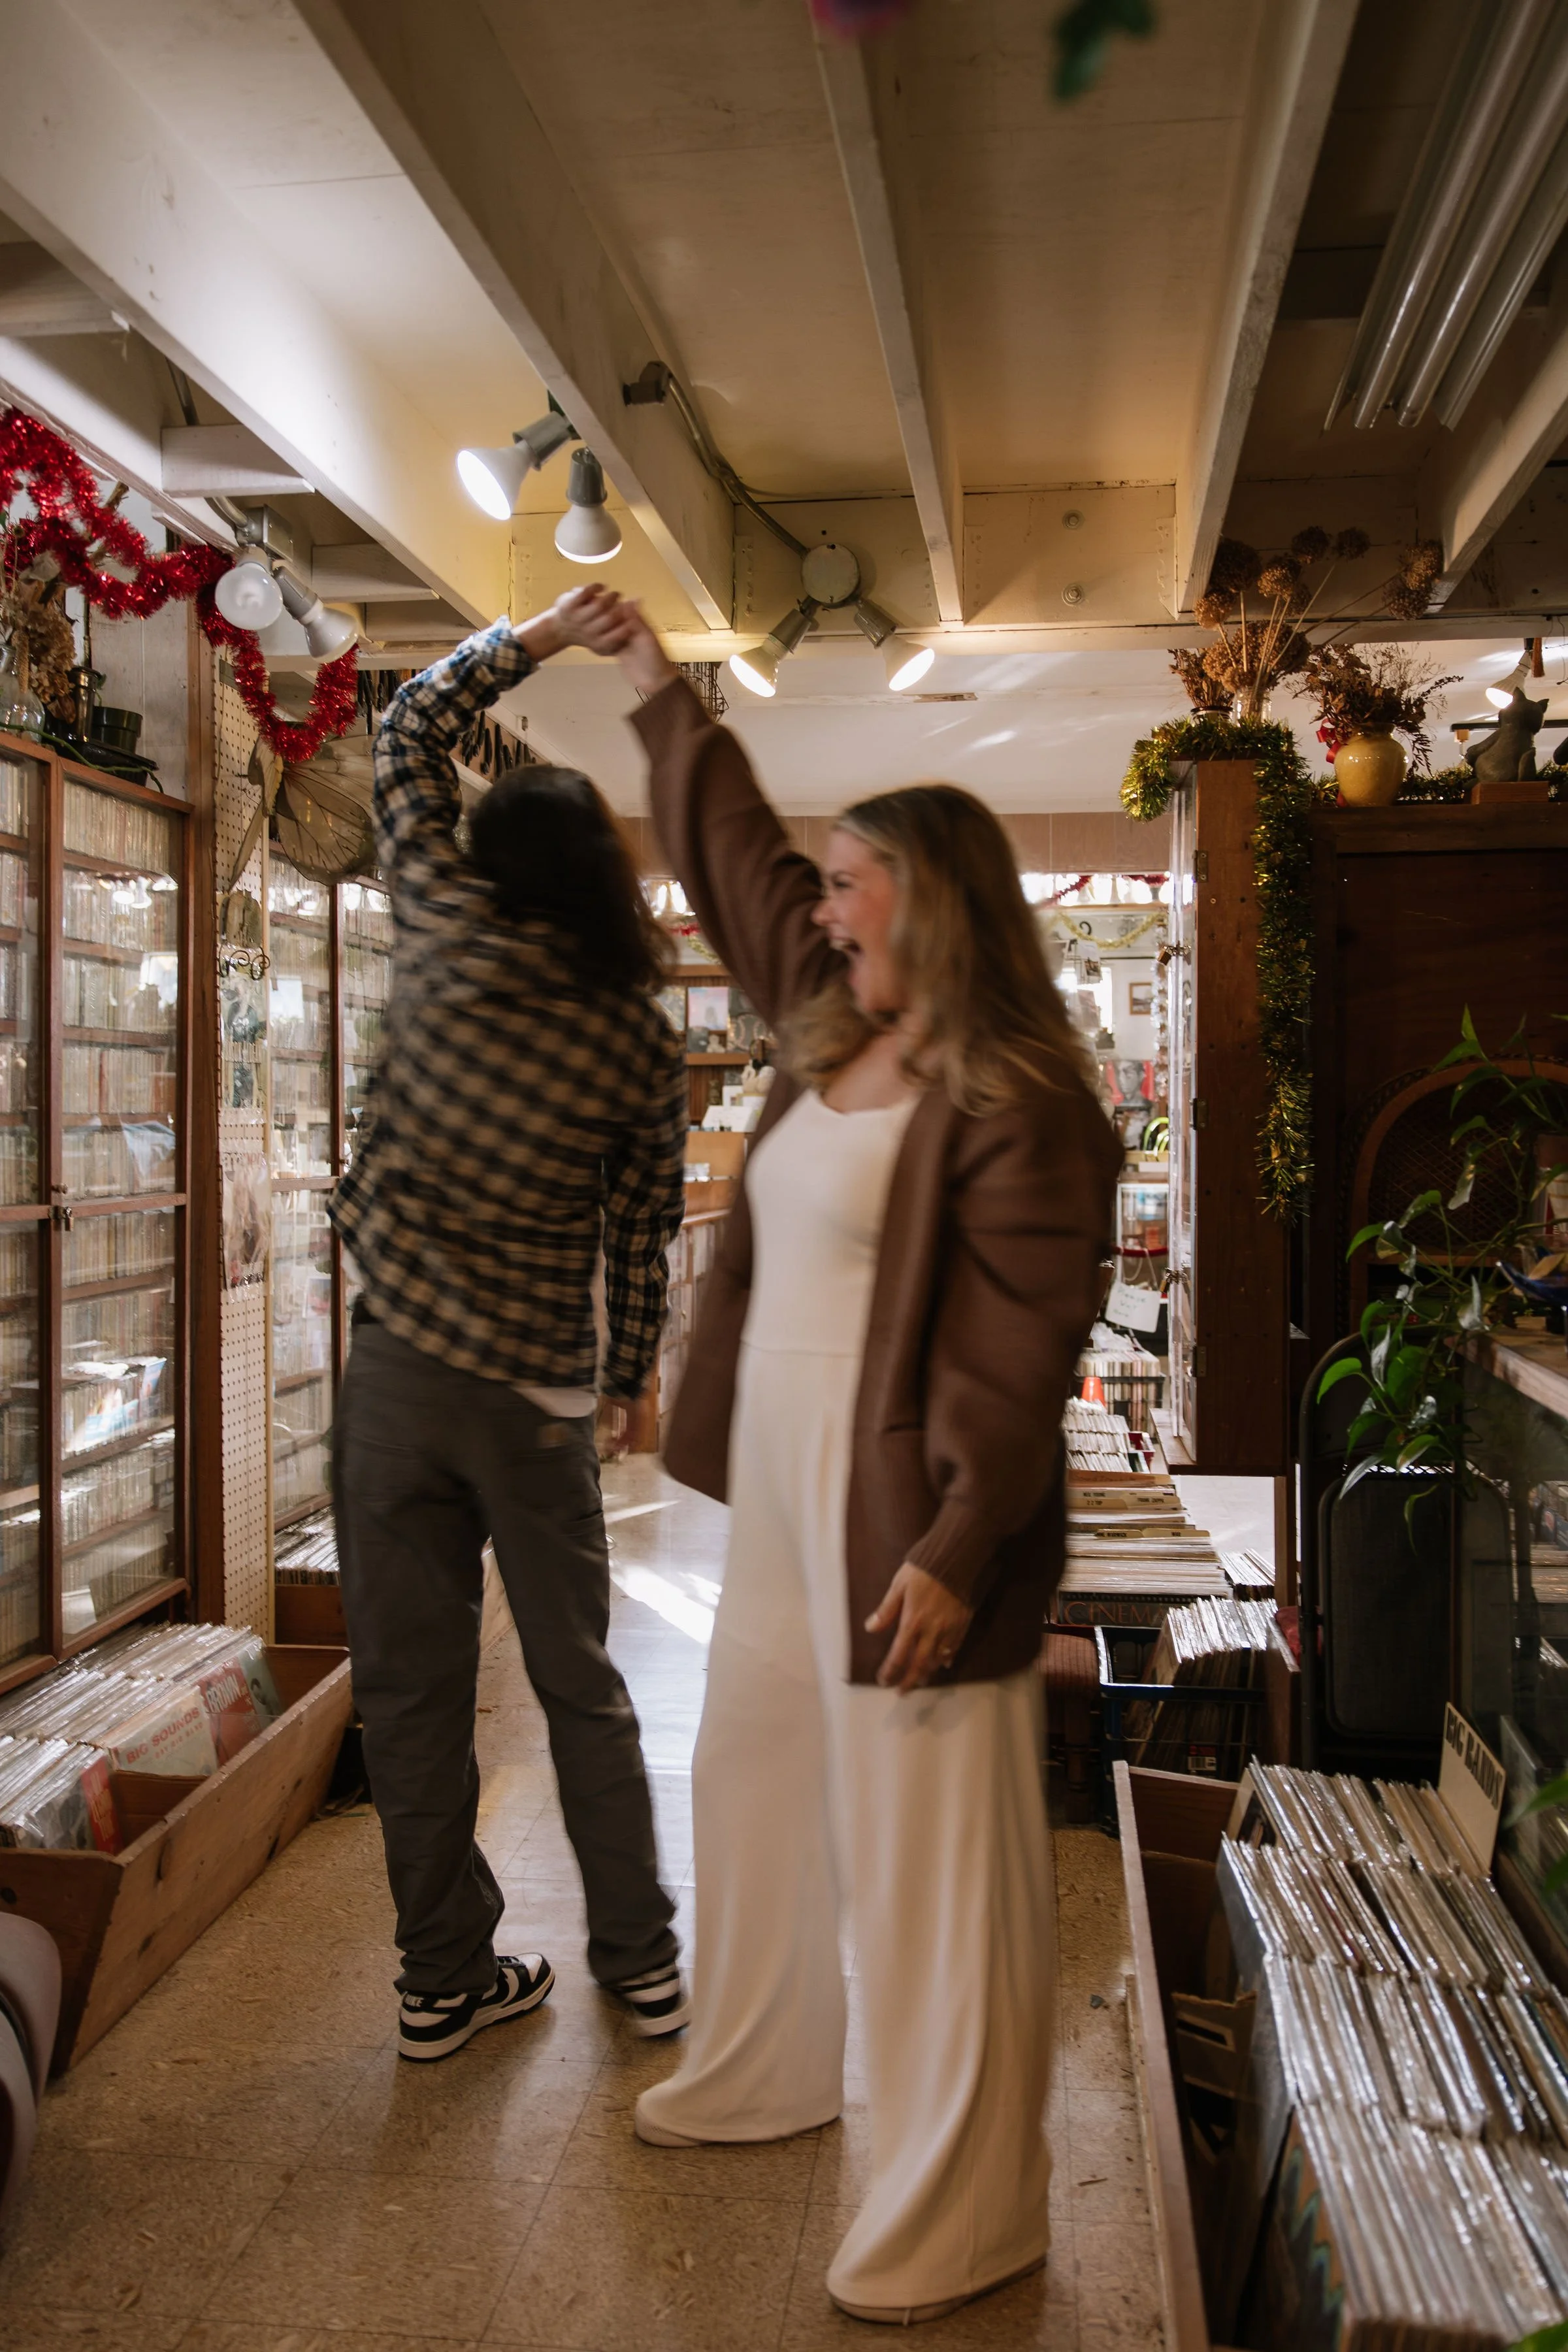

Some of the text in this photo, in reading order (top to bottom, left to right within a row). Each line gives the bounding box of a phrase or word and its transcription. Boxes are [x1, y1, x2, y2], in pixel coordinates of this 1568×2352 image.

[206, 1673, 242, 1713] BROWN
[126, 1707, 199, 1765] BIG SOUNDS
[1446, 1707, 1503, 1811] BIG BANDS
